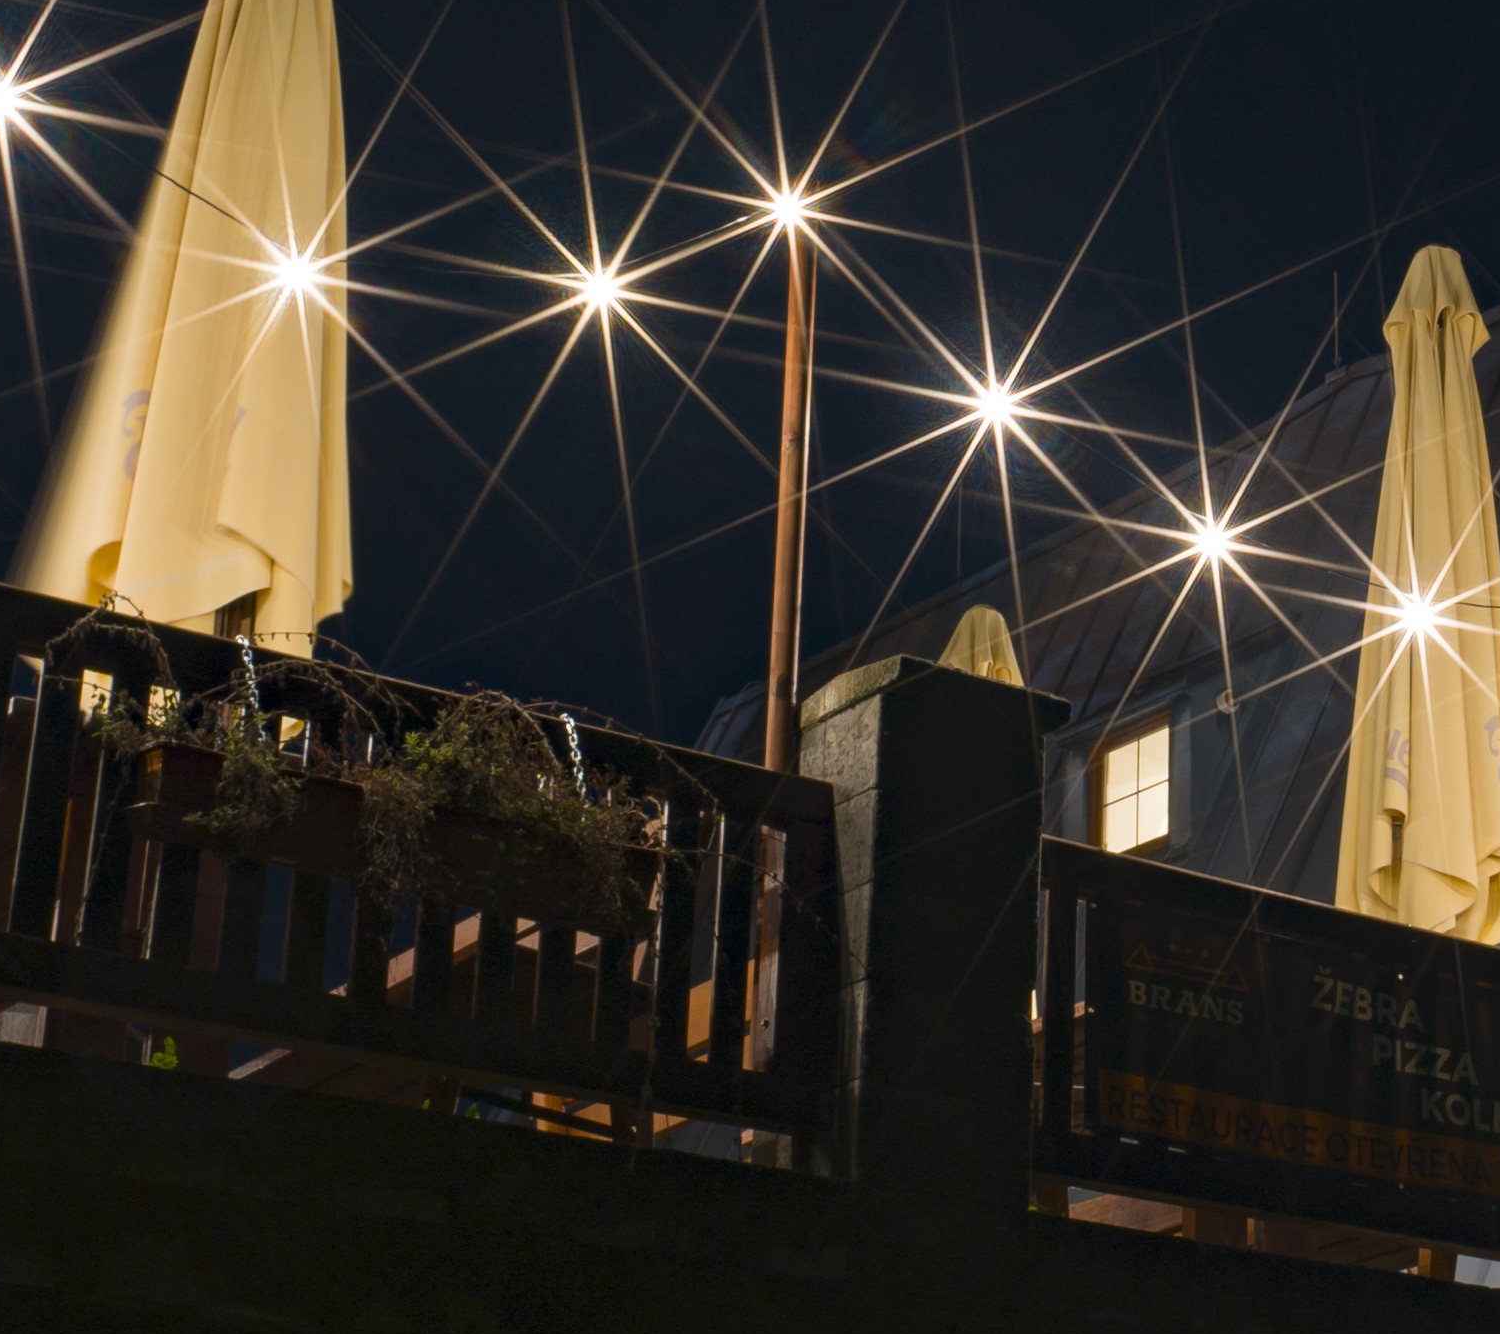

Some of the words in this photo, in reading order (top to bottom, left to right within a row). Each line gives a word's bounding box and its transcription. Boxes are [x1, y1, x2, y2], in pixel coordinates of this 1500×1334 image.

[1127, 979, 1244, 1025] BRANS
[1312, 965, 1425, 1032] ŽEBRA
[1372, 1035, 1479, 1085] PIZZA
[1106, 1084, 1316, 1159] RESTAURACE
